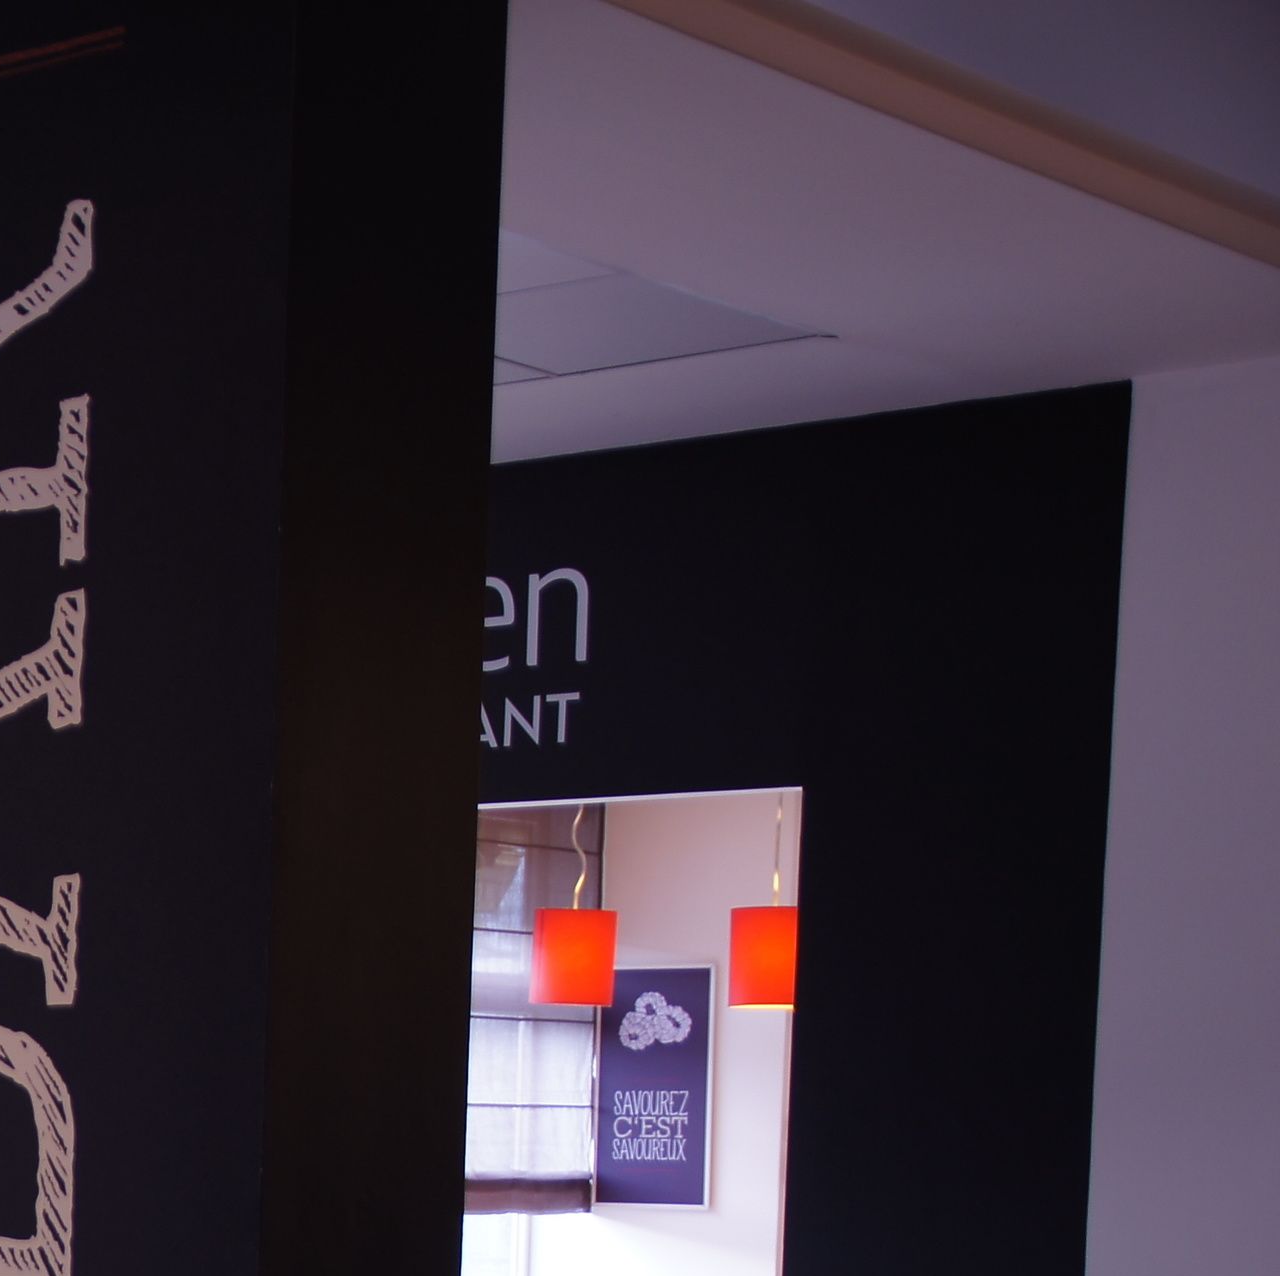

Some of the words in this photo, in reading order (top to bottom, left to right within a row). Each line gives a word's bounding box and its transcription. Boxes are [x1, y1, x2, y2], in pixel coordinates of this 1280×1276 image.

[614, 1090, 689, 1116] SAVOUREZ
[613, 1116, 688, 1139] C'EST
[612, 1138, 687, 1161] SAVOUREUX
